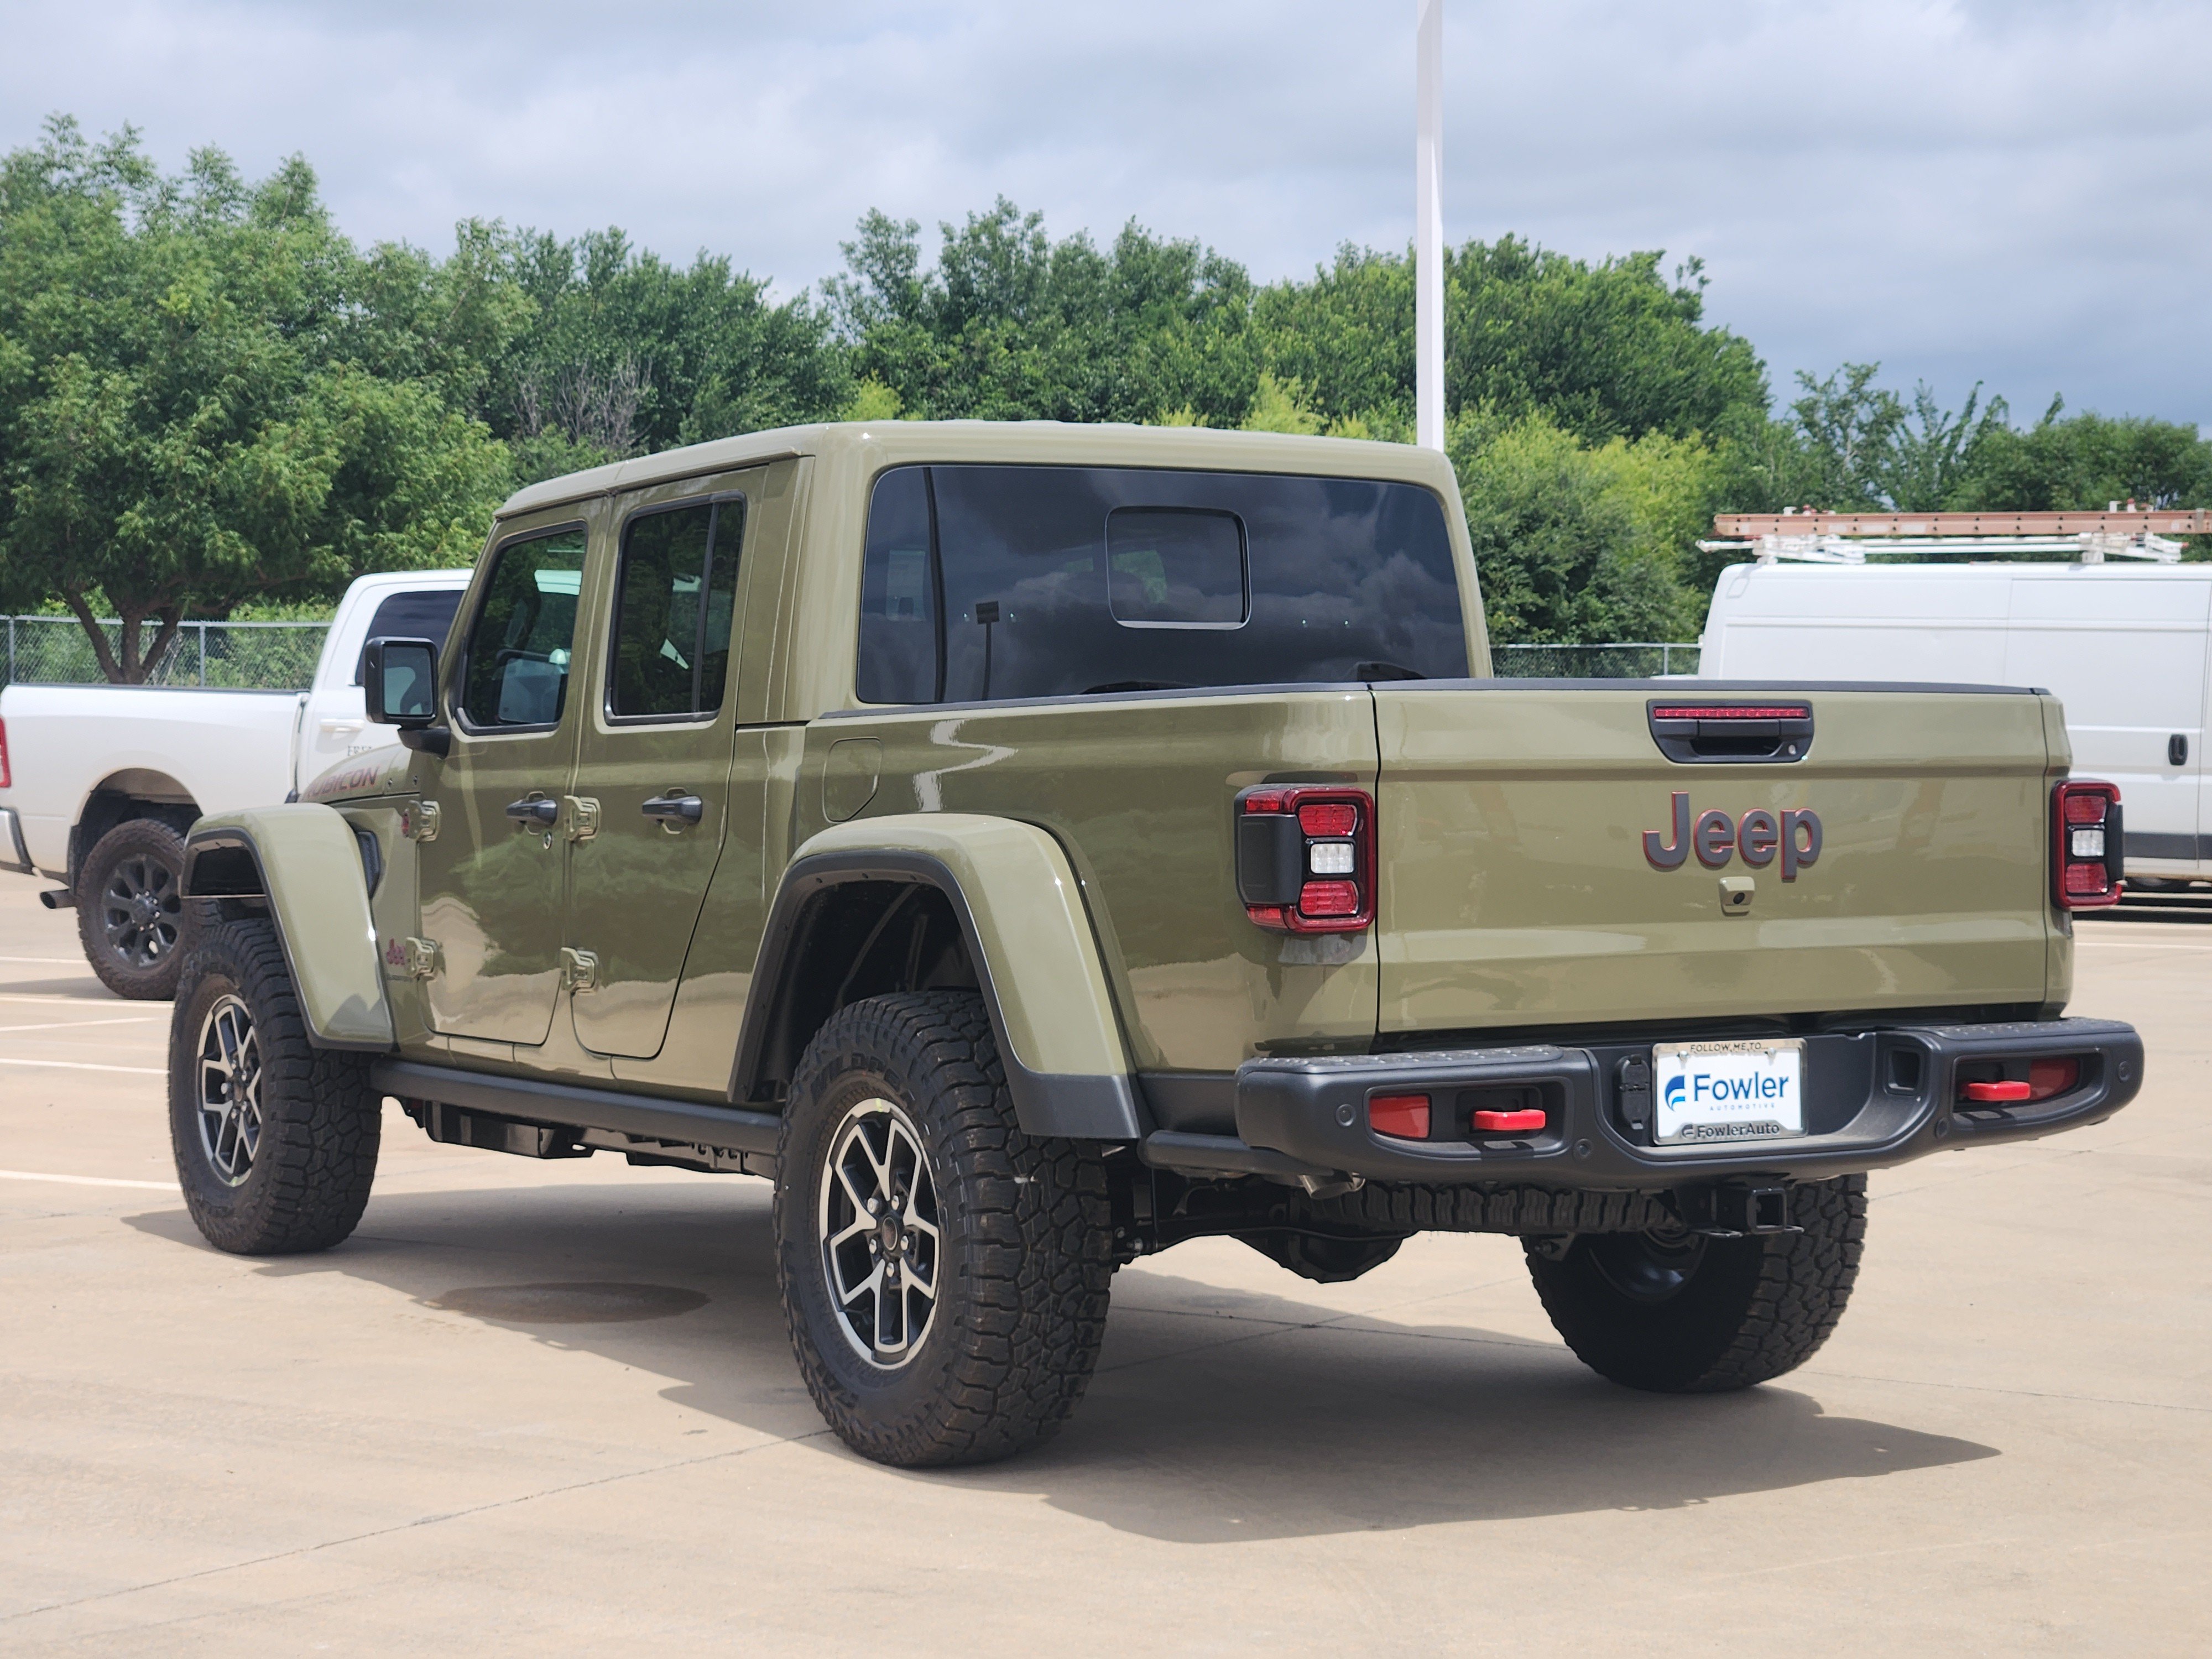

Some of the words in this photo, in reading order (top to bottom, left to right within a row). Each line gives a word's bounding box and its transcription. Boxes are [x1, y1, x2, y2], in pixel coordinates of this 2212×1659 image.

[1642, 791, 1822, 880] Jeep
[387, 938, 406, 966] Jee
[1690, 1043, 1730, 1052] FOLLOW
[1733, 1042, 1746, 1051] ME
[1693, 1071, 1790, 1102] Fowler
[1709, 1103, 1775, 1111] AUTOMOTIVE
[1697, 1123, 1780, 1140] FowlerAuto
